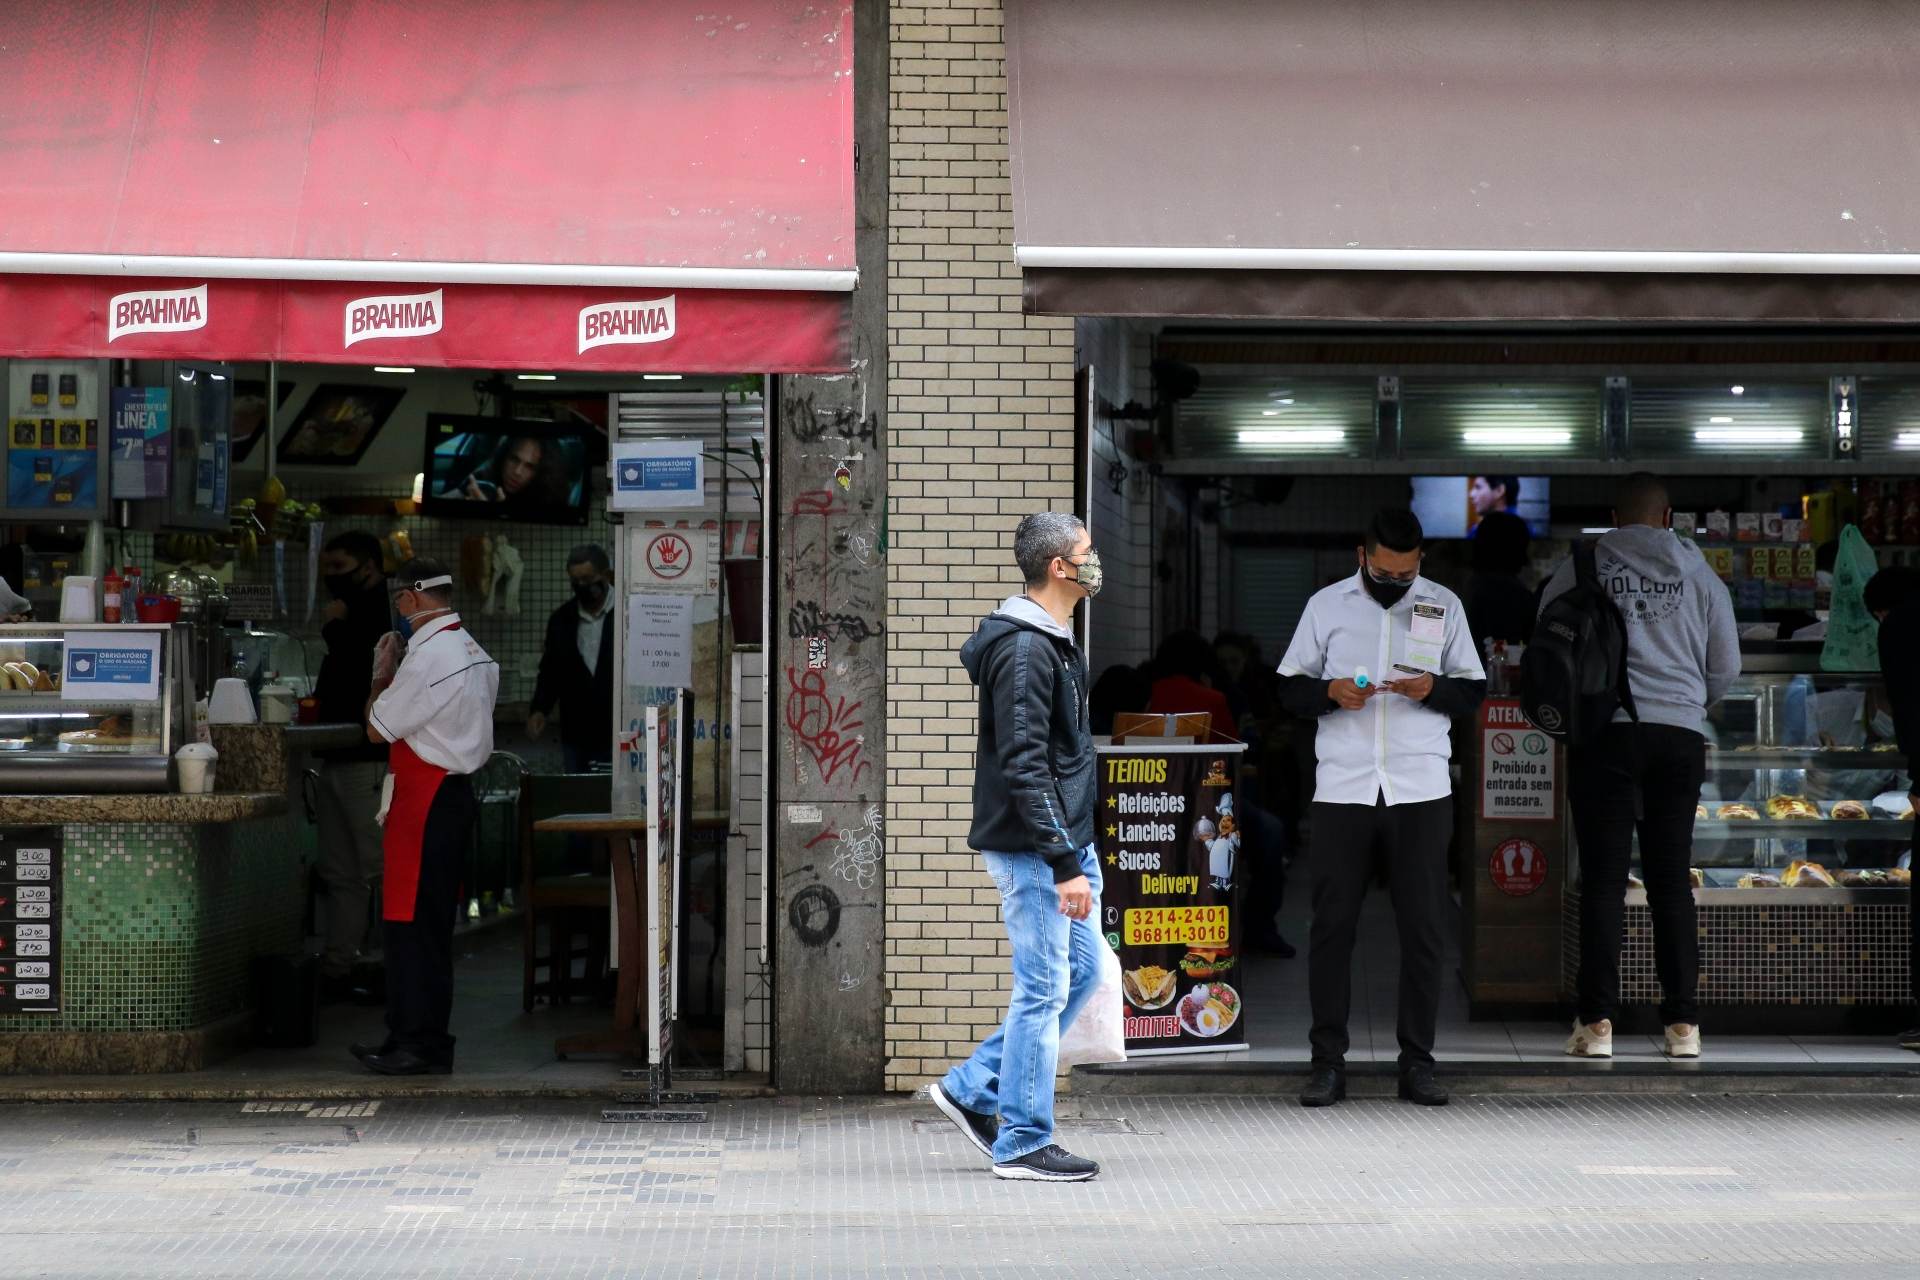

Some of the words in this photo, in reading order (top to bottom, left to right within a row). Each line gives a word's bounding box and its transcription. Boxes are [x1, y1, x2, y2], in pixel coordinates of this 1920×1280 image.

[117, 296, 201, 328] BRAHMA
[352, 301, 436, 334] BRAHMA
[586, 307, 669, 340] BRAHMA
[117, 411, 157, 430] LINEA
[1106, 759, 1168, 784] TEMOS
[1492, 760, 1537, 775] Proibido
[1540, 765, 1547, 775] a
[1486, 777, 1528, 791] entrada
[1531, 780, 1553, 791] sem
[1118, 791, 1186, 817] Refeições
[1118, 821, 1176, 842] Lanches
[1118, 849, 1161, 870] Sucos
[1141, 874, 1199, 896] Delivery
[1133, 907, 1226, 925] 3214-2401
[1133, 926, 1227, 944] 96811-3016
